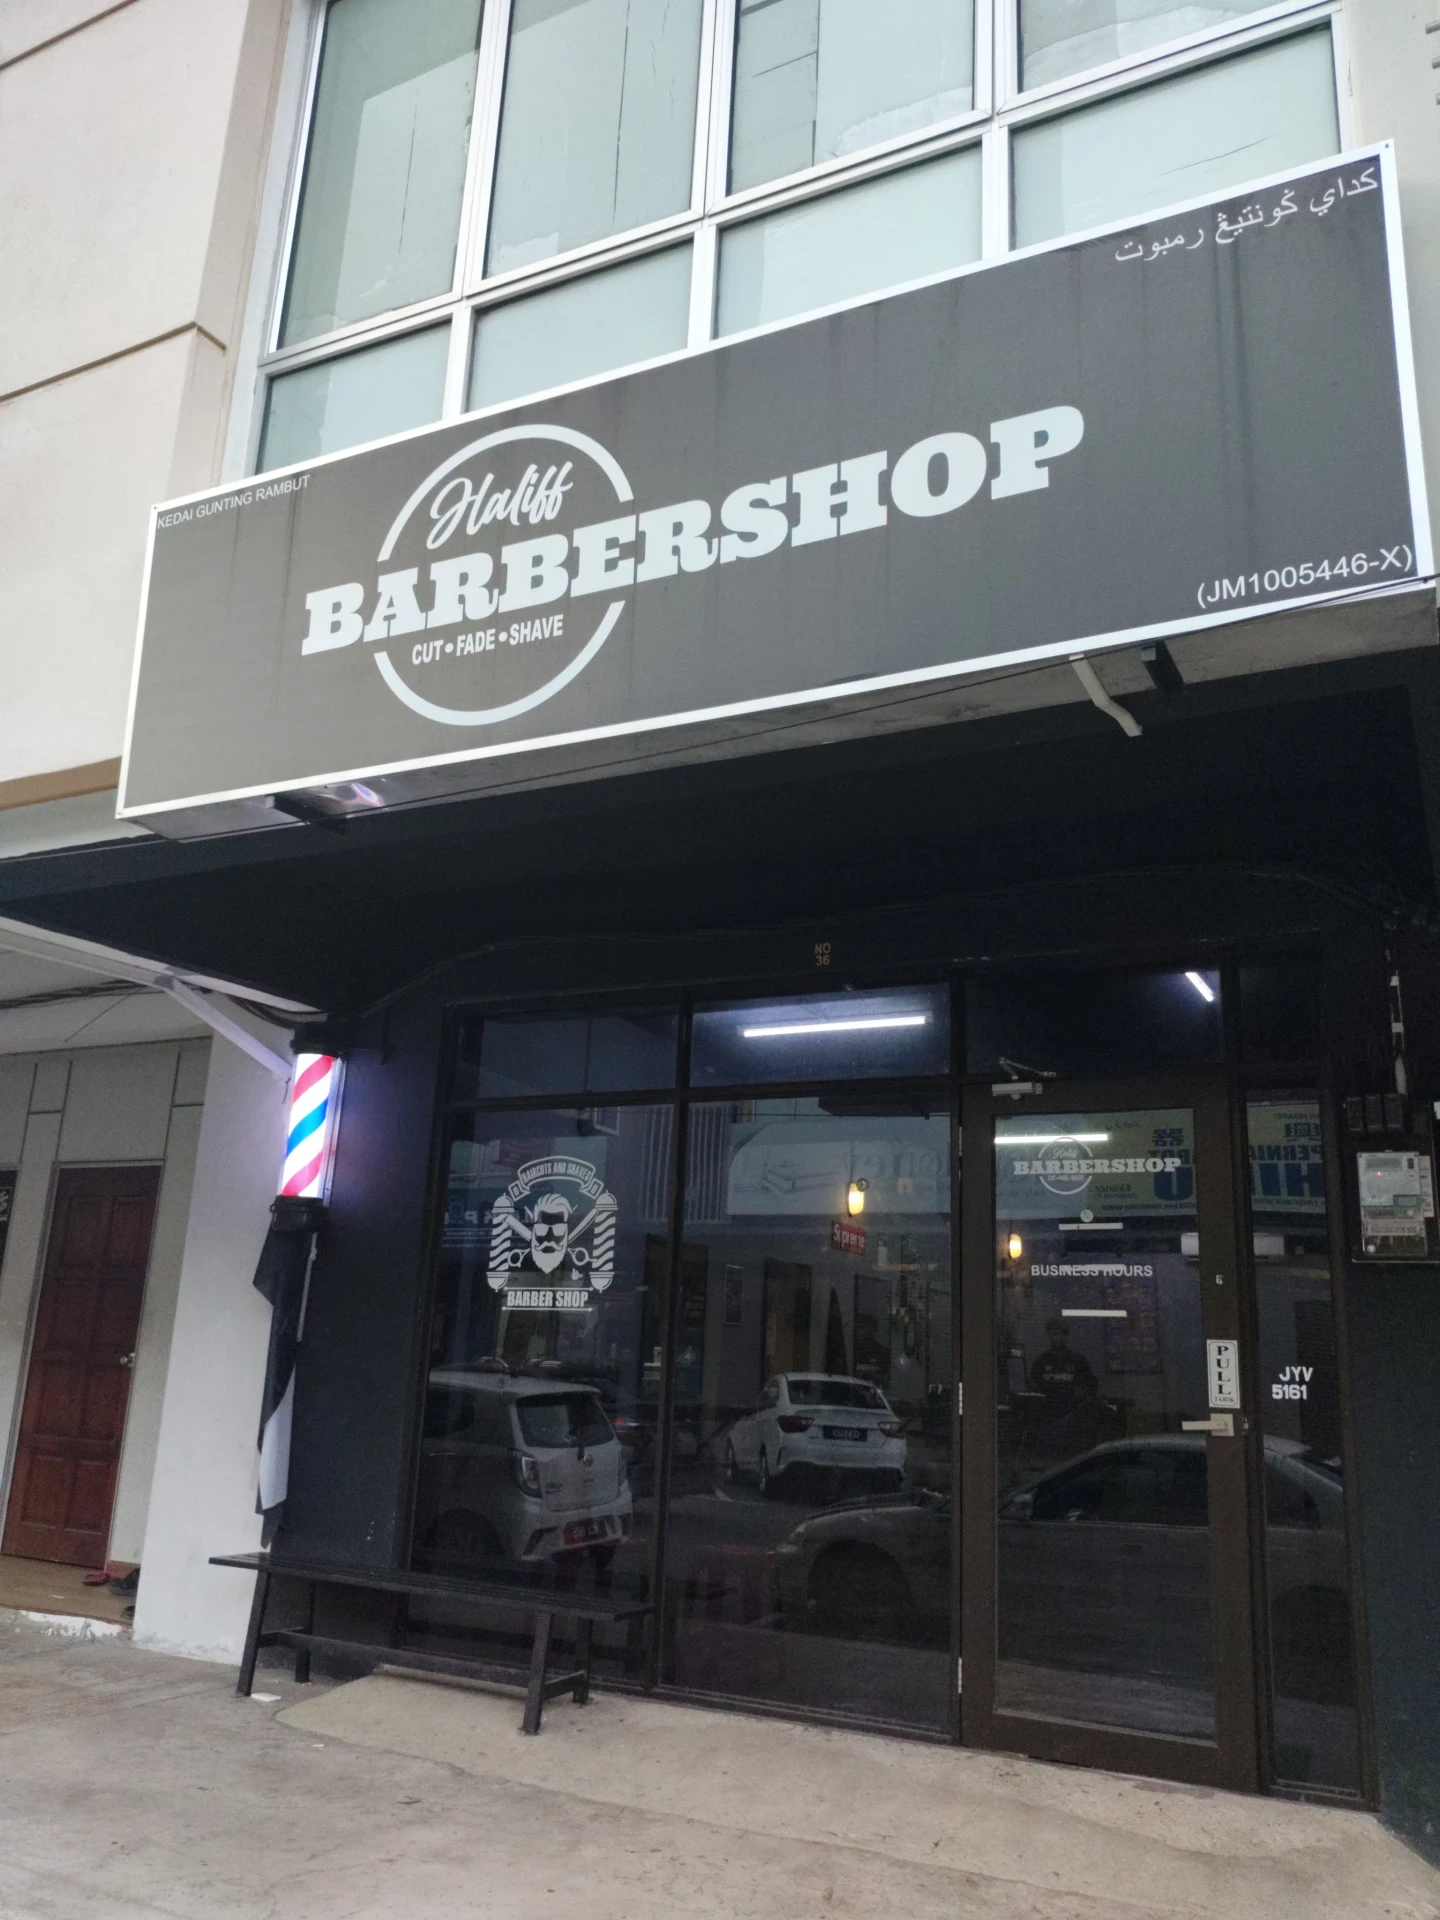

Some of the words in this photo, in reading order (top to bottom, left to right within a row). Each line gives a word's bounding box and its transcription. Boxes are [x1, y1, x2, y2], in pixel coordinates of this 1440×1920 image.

[157, 508, 193, 529] KEDAI
[196, 491, 253, 518] GUNTING
[255, 475, 310, 502] RAMBUT
[426, 461, 574, 550] Haliff
[301, 405, 1085, 656] BARBERSHOP
[1197, 543, 1412, 609] (JM1005446-X)
[815, 942, 831, 954] NO
[816, 954, 830, 966] 36
[522, 1162, 552, 1184] HAIRCUTS
[553, 1161, 567, 1173] AND
[567, 1162, 592, 1181] SHAVES
[1013, 1157, 1181, 1175] BARBERSHOP
[1031, 1264, 1099, 1277] BUSINESS
[1103, 1264, 1153, 1277] HOURS
[507, 1290, 553, 1308] BARBER
[555, 1290, 589, 1308] SHOP
[1215, 1345, 1232, 1395] PULL
[1279, 1366, 1314, 1382] JYV
[1271, 1383, 1308, 1400] 5161
